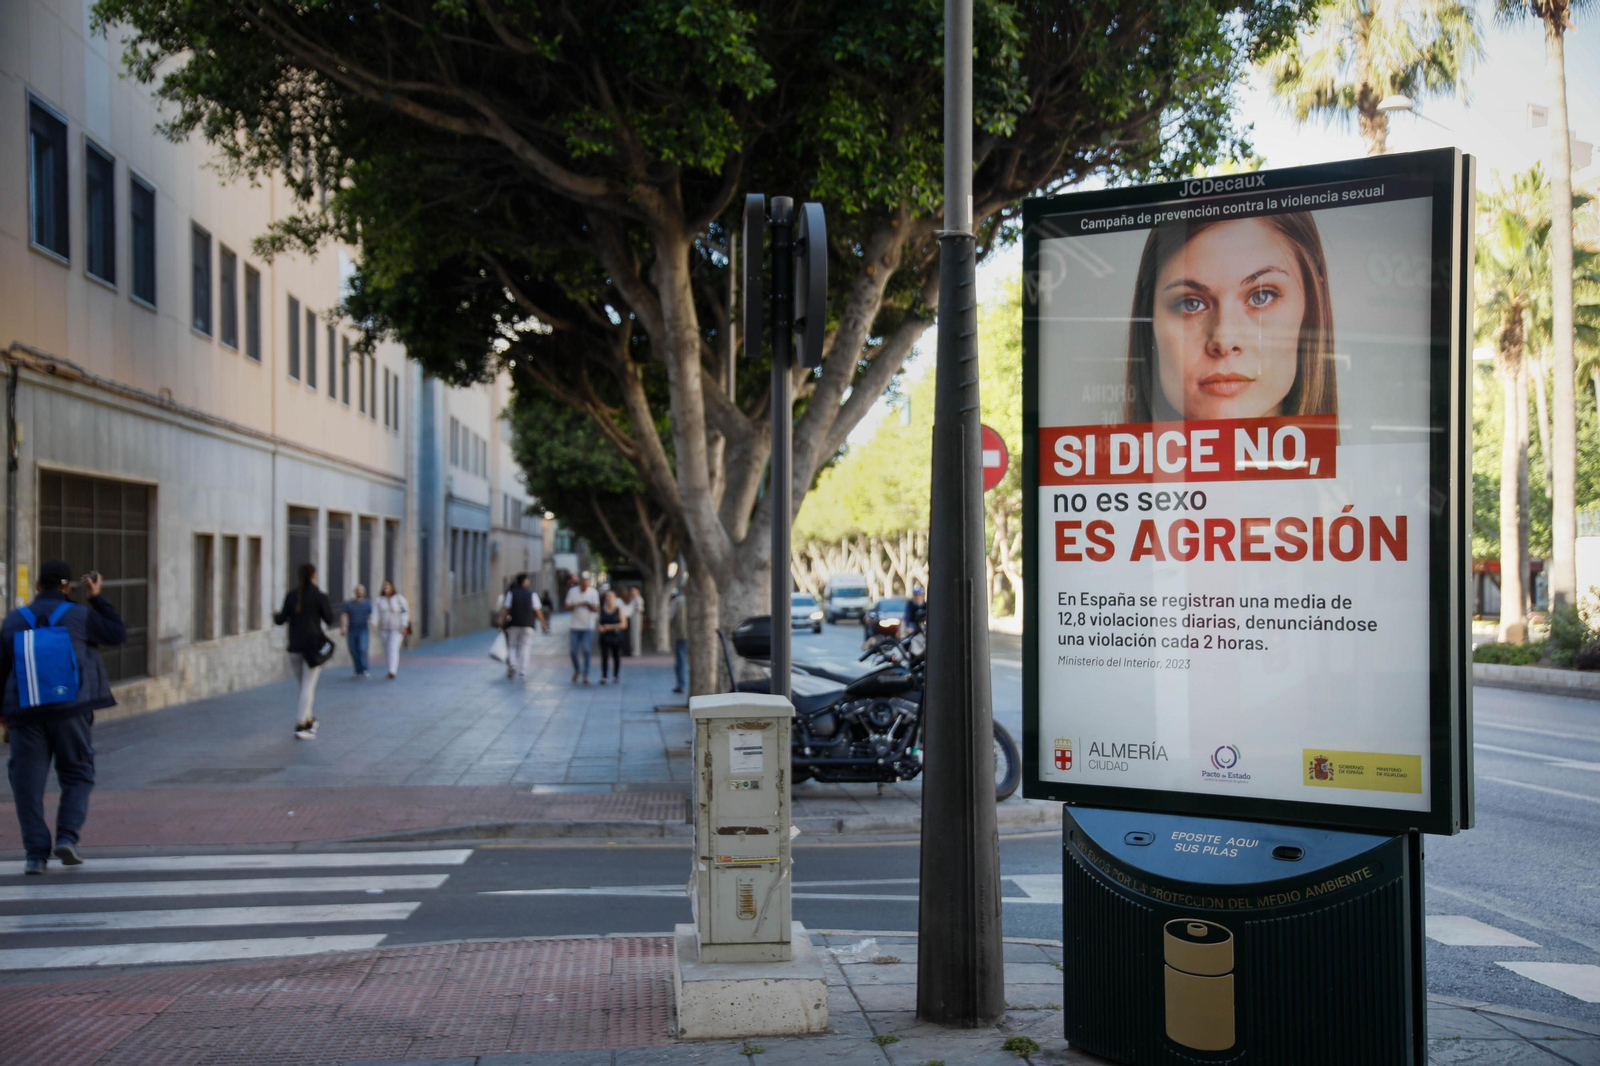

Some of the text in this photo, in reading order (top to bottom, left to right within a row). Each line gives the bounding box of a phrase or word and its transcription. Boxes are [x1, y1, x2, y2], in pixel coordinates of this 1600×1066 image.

[1179, 174, 1266, 197] JCDecaux
[1080, 184, 1385, 230] Campaña de prevención contra la violencia sexual
[1053, 434, 1096, 477] SI
[1109, 429, 1220, 475] DICE
[1233, 425, 1321, 475] NO,
[1053, 490, 1207, 513] no es sexo
[1054, 504, 1408, 562] ES AGRESIÓN
[1058, 592, 1352, 610] En España se registran una media de
[1058, 612, 1378, 632] 12,8 violaciones diarias, denunciándose
[1058, 632, 1268, 650] una violación cada 2 horas.
[1057, 655, 1191, 670] Ministerio del Interior, 2023
[1088, 741, 1169, 761] ALMERÍA
[1088, 760, 1129, 772] CIUDAD
[1201, 770, 1220, 778] Pacto
[1228, 772, 1251, 780] Estado
[1174, 842, 1238, 858] SUS PILAS
[1226, 837, 1259, 848] AQUI
[1077, 838, 1111, 874] VELEMOS
[1112, 868, 1131, 886] POR
[1133, 879, 1146, 894] LA
[1228, 898, 1253, 909] DEL
[1305, 866, 1373, 899] AMBIENTE
